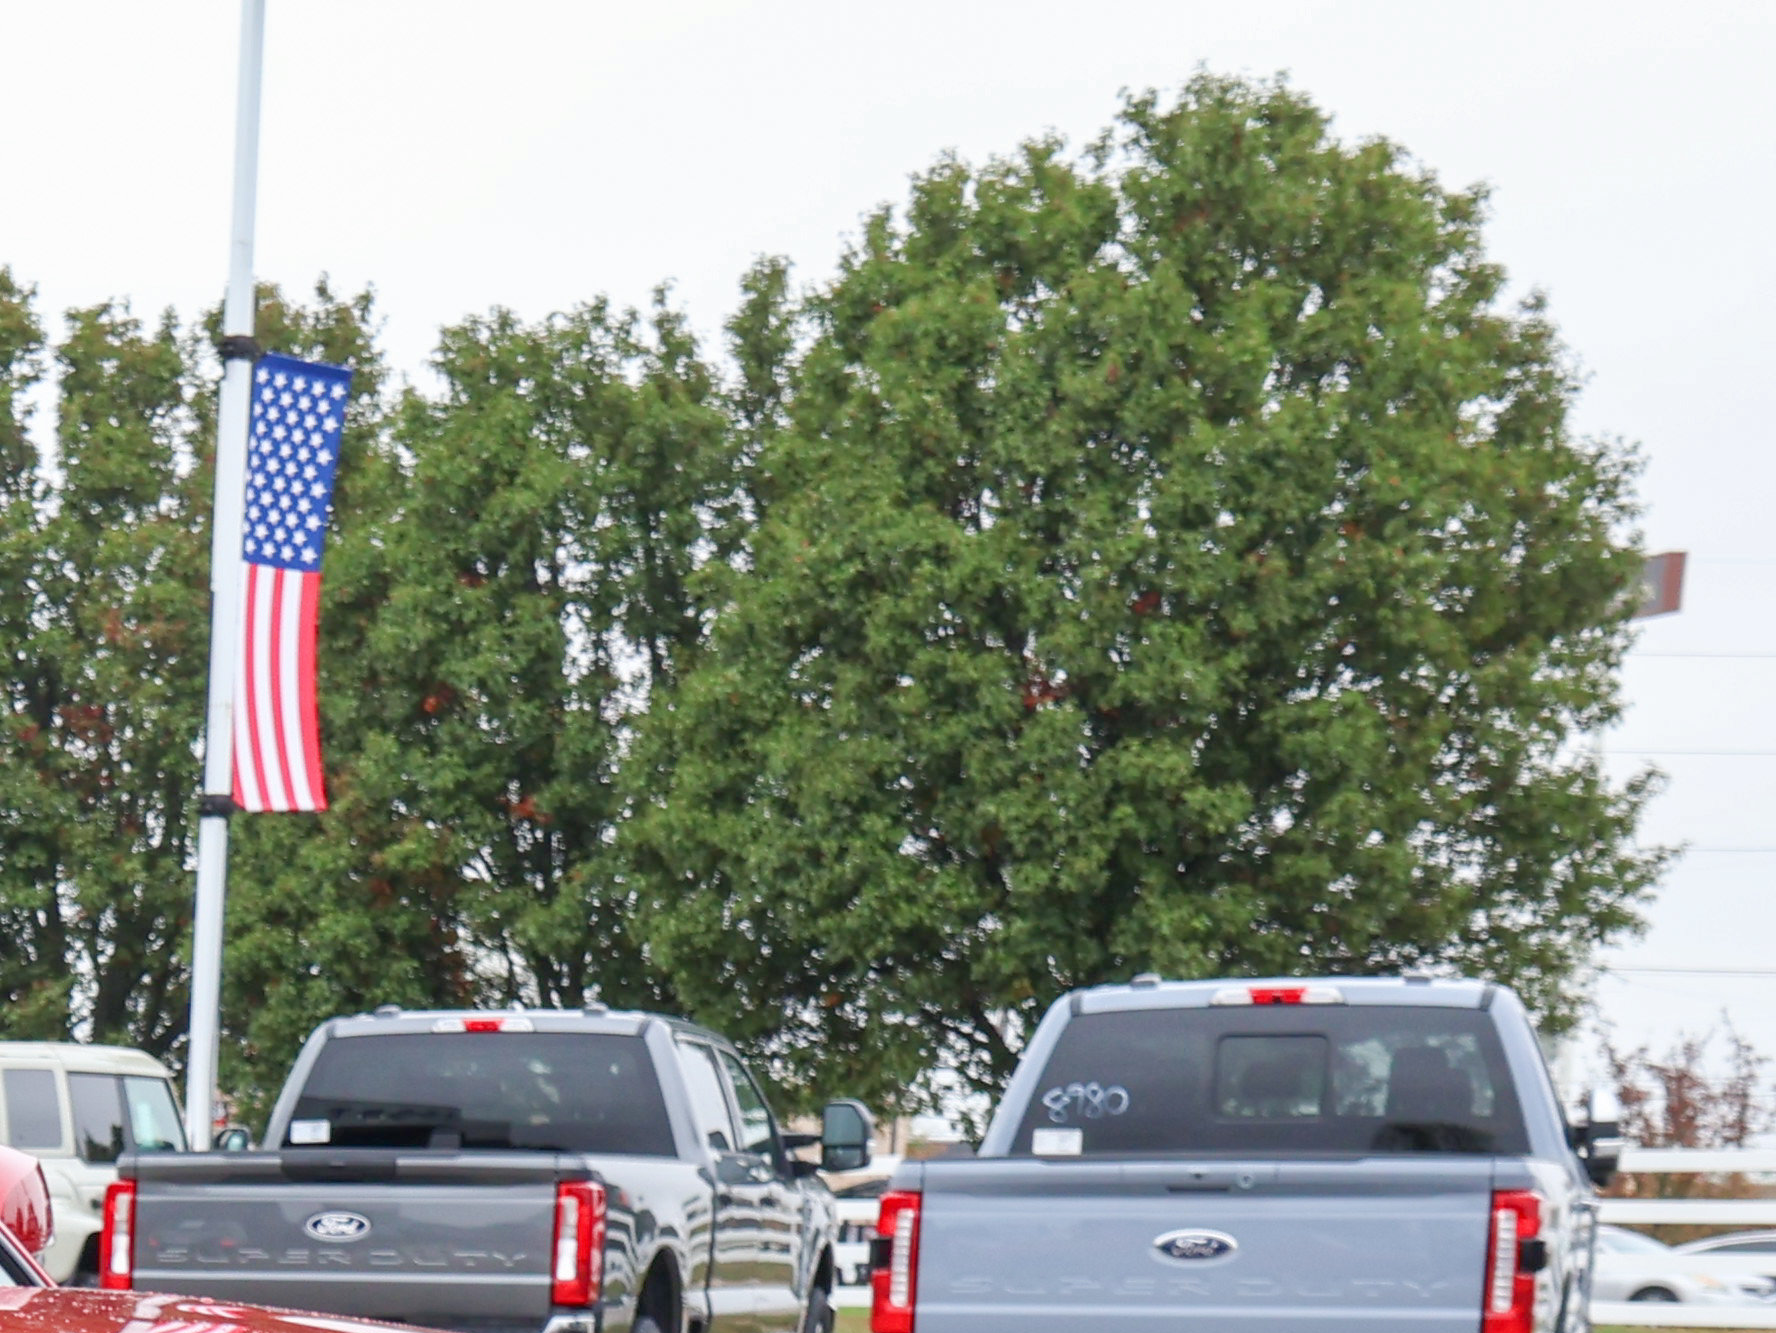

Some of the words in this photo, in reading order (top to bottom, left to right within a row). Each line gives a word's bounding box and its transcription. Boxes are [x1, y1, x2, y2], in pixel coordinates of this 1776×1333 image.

[1042, 1081, 1130, 1123] 8980
[157, 1248, 352, 1265] SUPER
[369, 1249, 528, 1267] DUTY
[950, 1276, 1212, 1297] SUPER
[1238, 1277, 1448, 1299] DUTY
